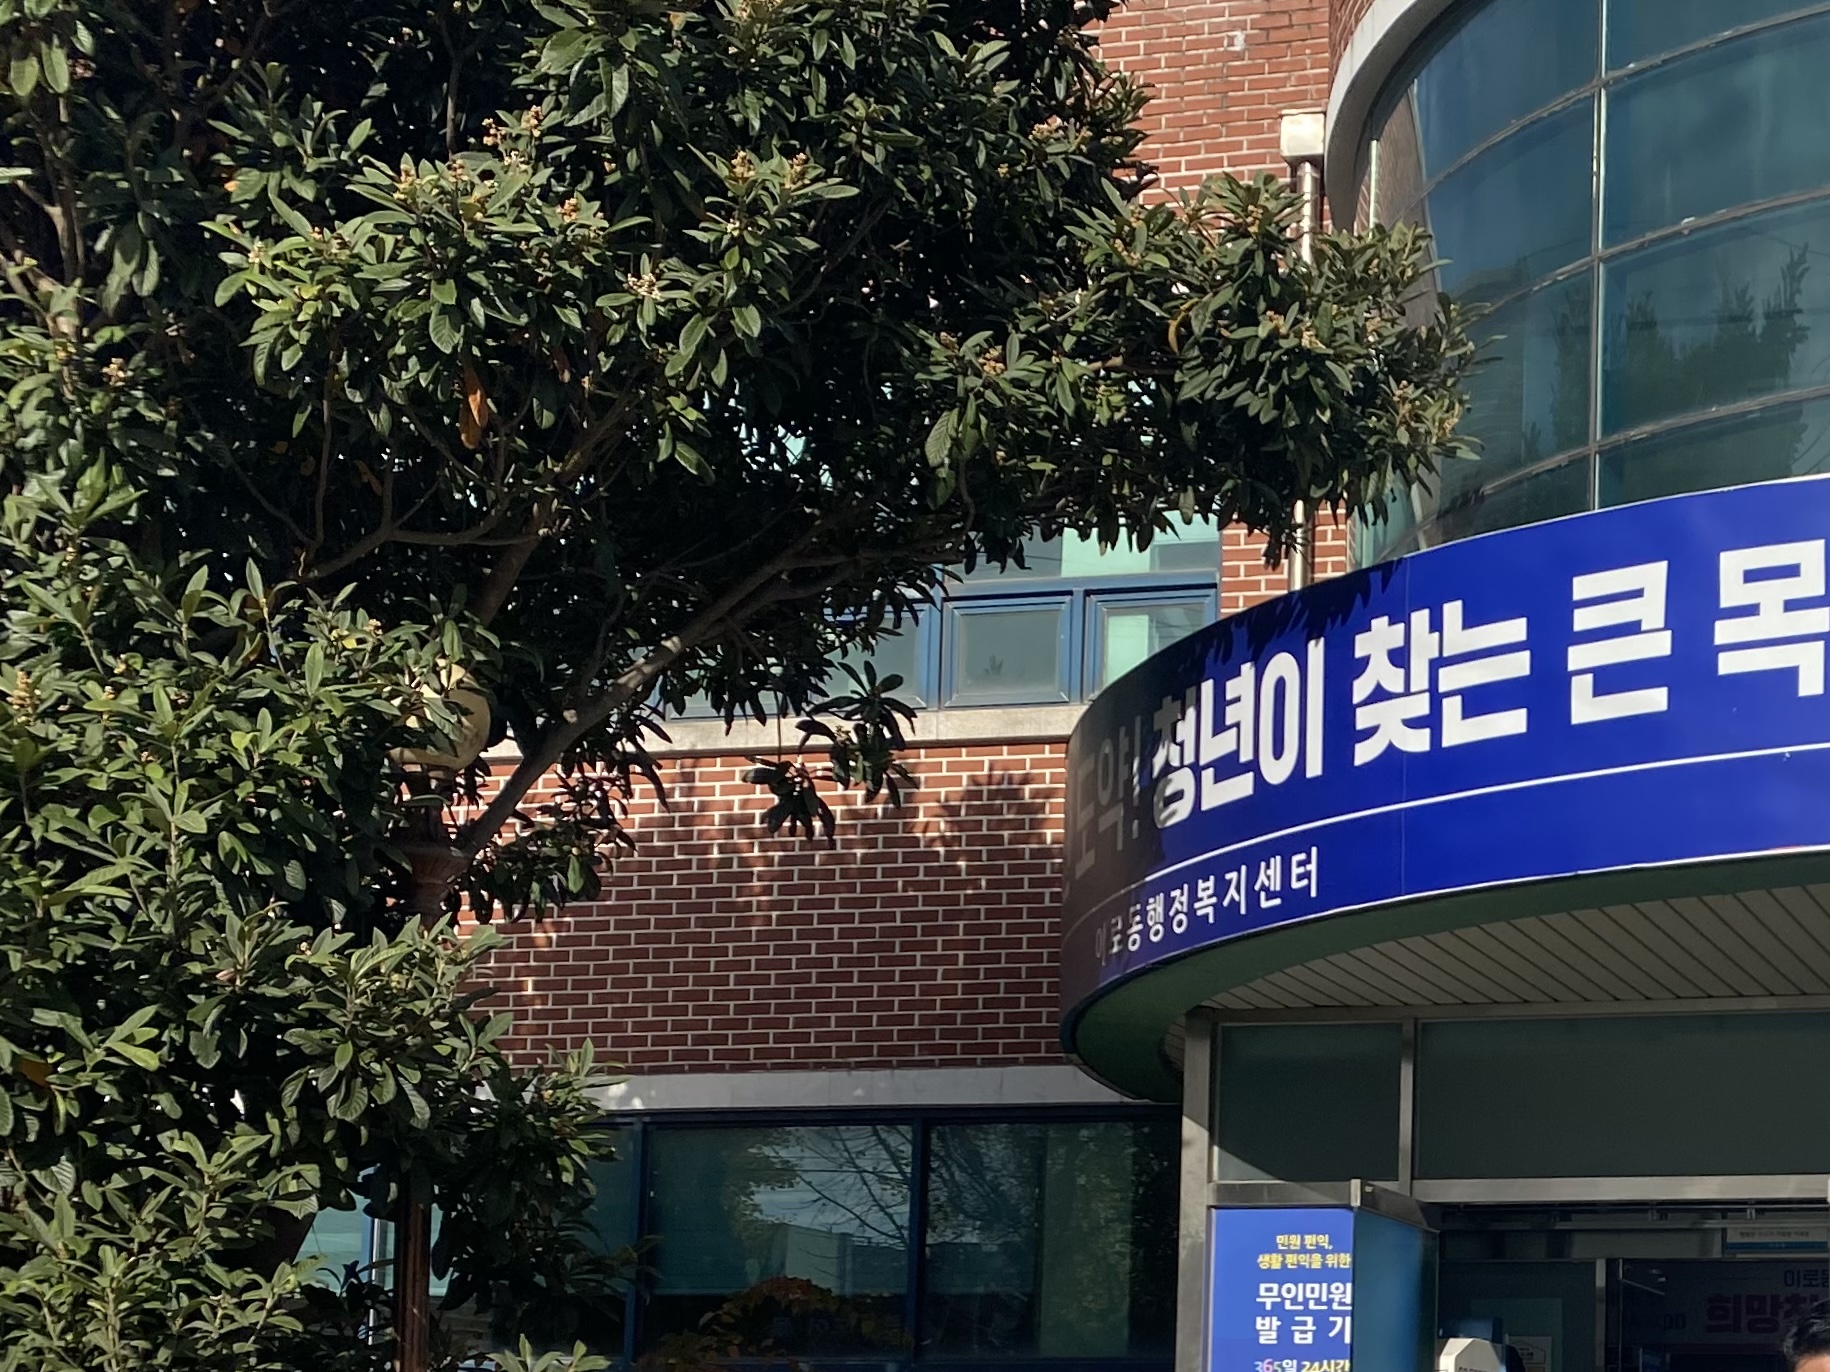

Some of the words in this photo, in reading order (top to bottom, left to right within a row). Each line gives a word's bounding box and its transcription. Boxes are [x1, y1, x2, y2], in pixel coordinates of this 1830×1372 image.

[1153, 637, 1325, 829] 청년이
[1353, 599, 1529, 767] 찾는
[1568, 560, 1672, 725] 큰
[1095, 846, 1318, 967] 이로동행정복지센터
[1276, 1234, 1301, 1250] 민원
[1257, 1253, 1283, 1270] 생활
[1285, 1253, 1322, 1269] 편익을
[1256, 1282, 1352, 1311] 무인민원
